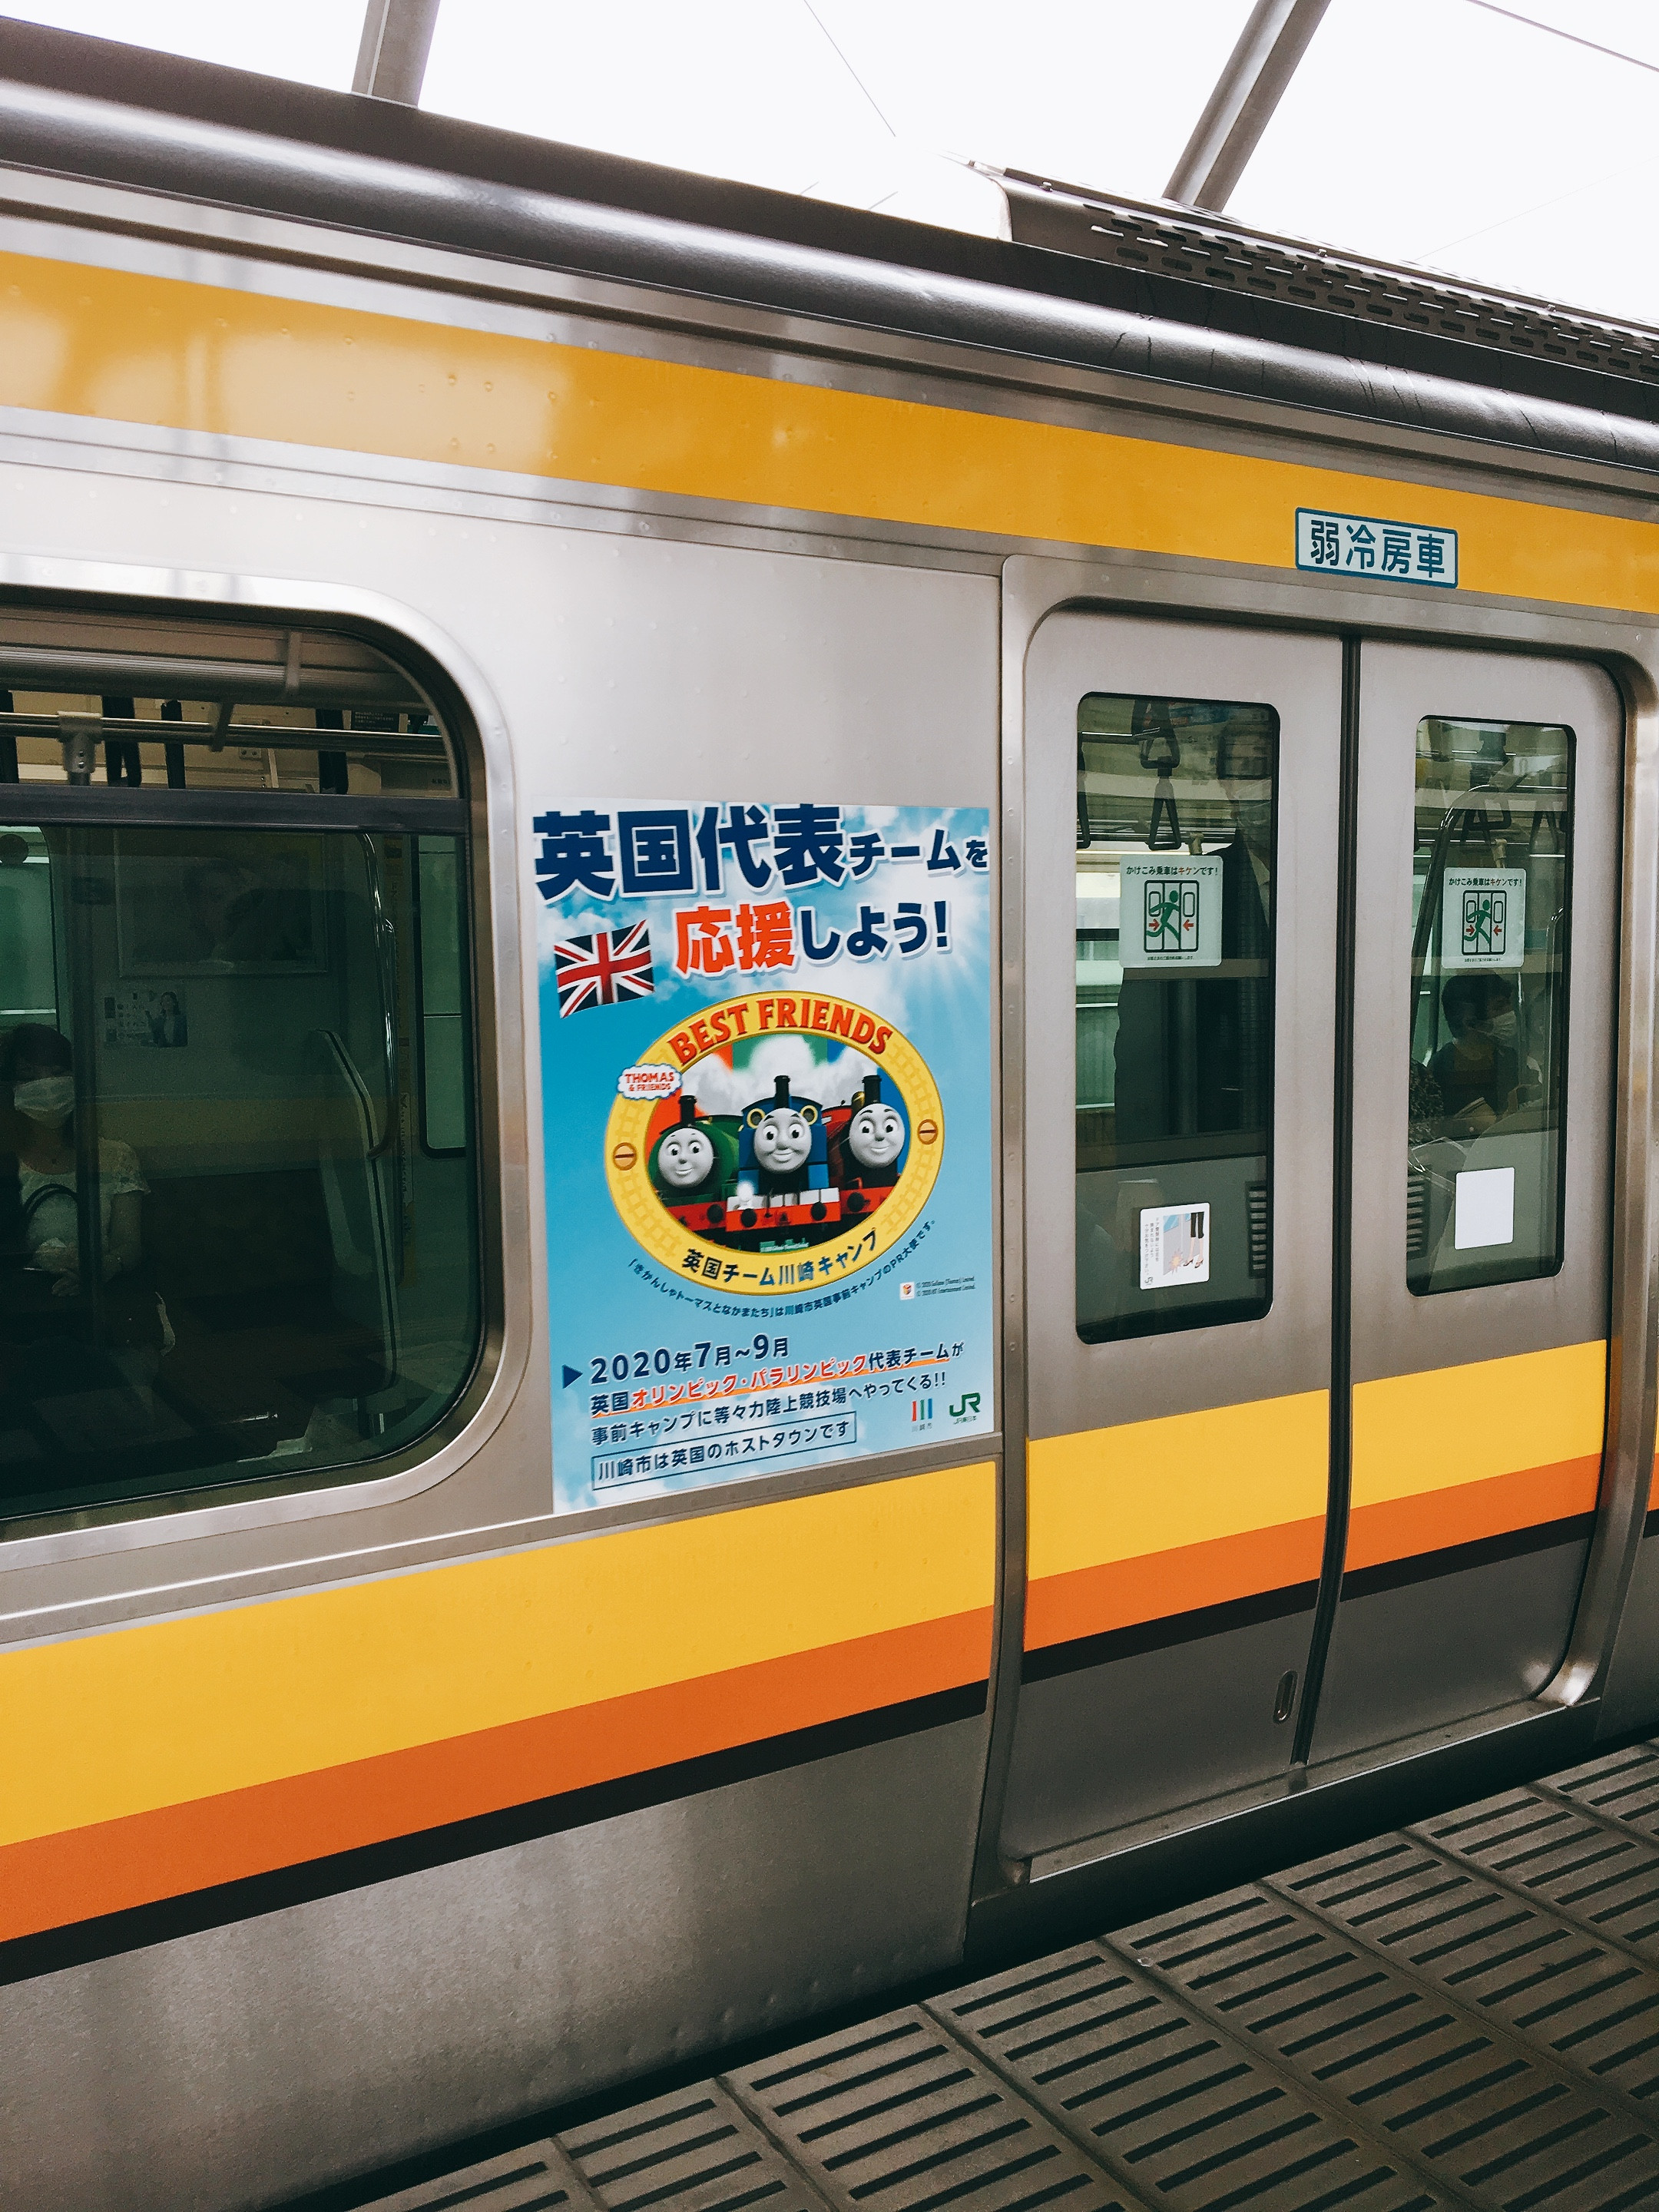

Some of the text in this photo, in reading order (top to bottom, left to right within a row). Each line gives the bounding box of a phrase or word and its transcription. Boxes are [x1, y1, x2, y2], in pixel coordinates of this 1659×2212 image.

[1310, 519, 1445, 578] 弱冷房車
[533, 803, 988, 900] 英国代表チームを
[676, 900, 947, 974] 応援しよう!
[668, 998, 894, 1065] BEST FRIENDS
[624, 1071, 675, 1084] THOMAS
[637, 1083, 671, 1091] FRIENDS
[681, 1227, 878, 1286] 英国チーム川崎キャンプ
[949, 1392, 981, 1417] JR
[598, 1420, 849, 1480] 川崎市は英国のホストタウンです
